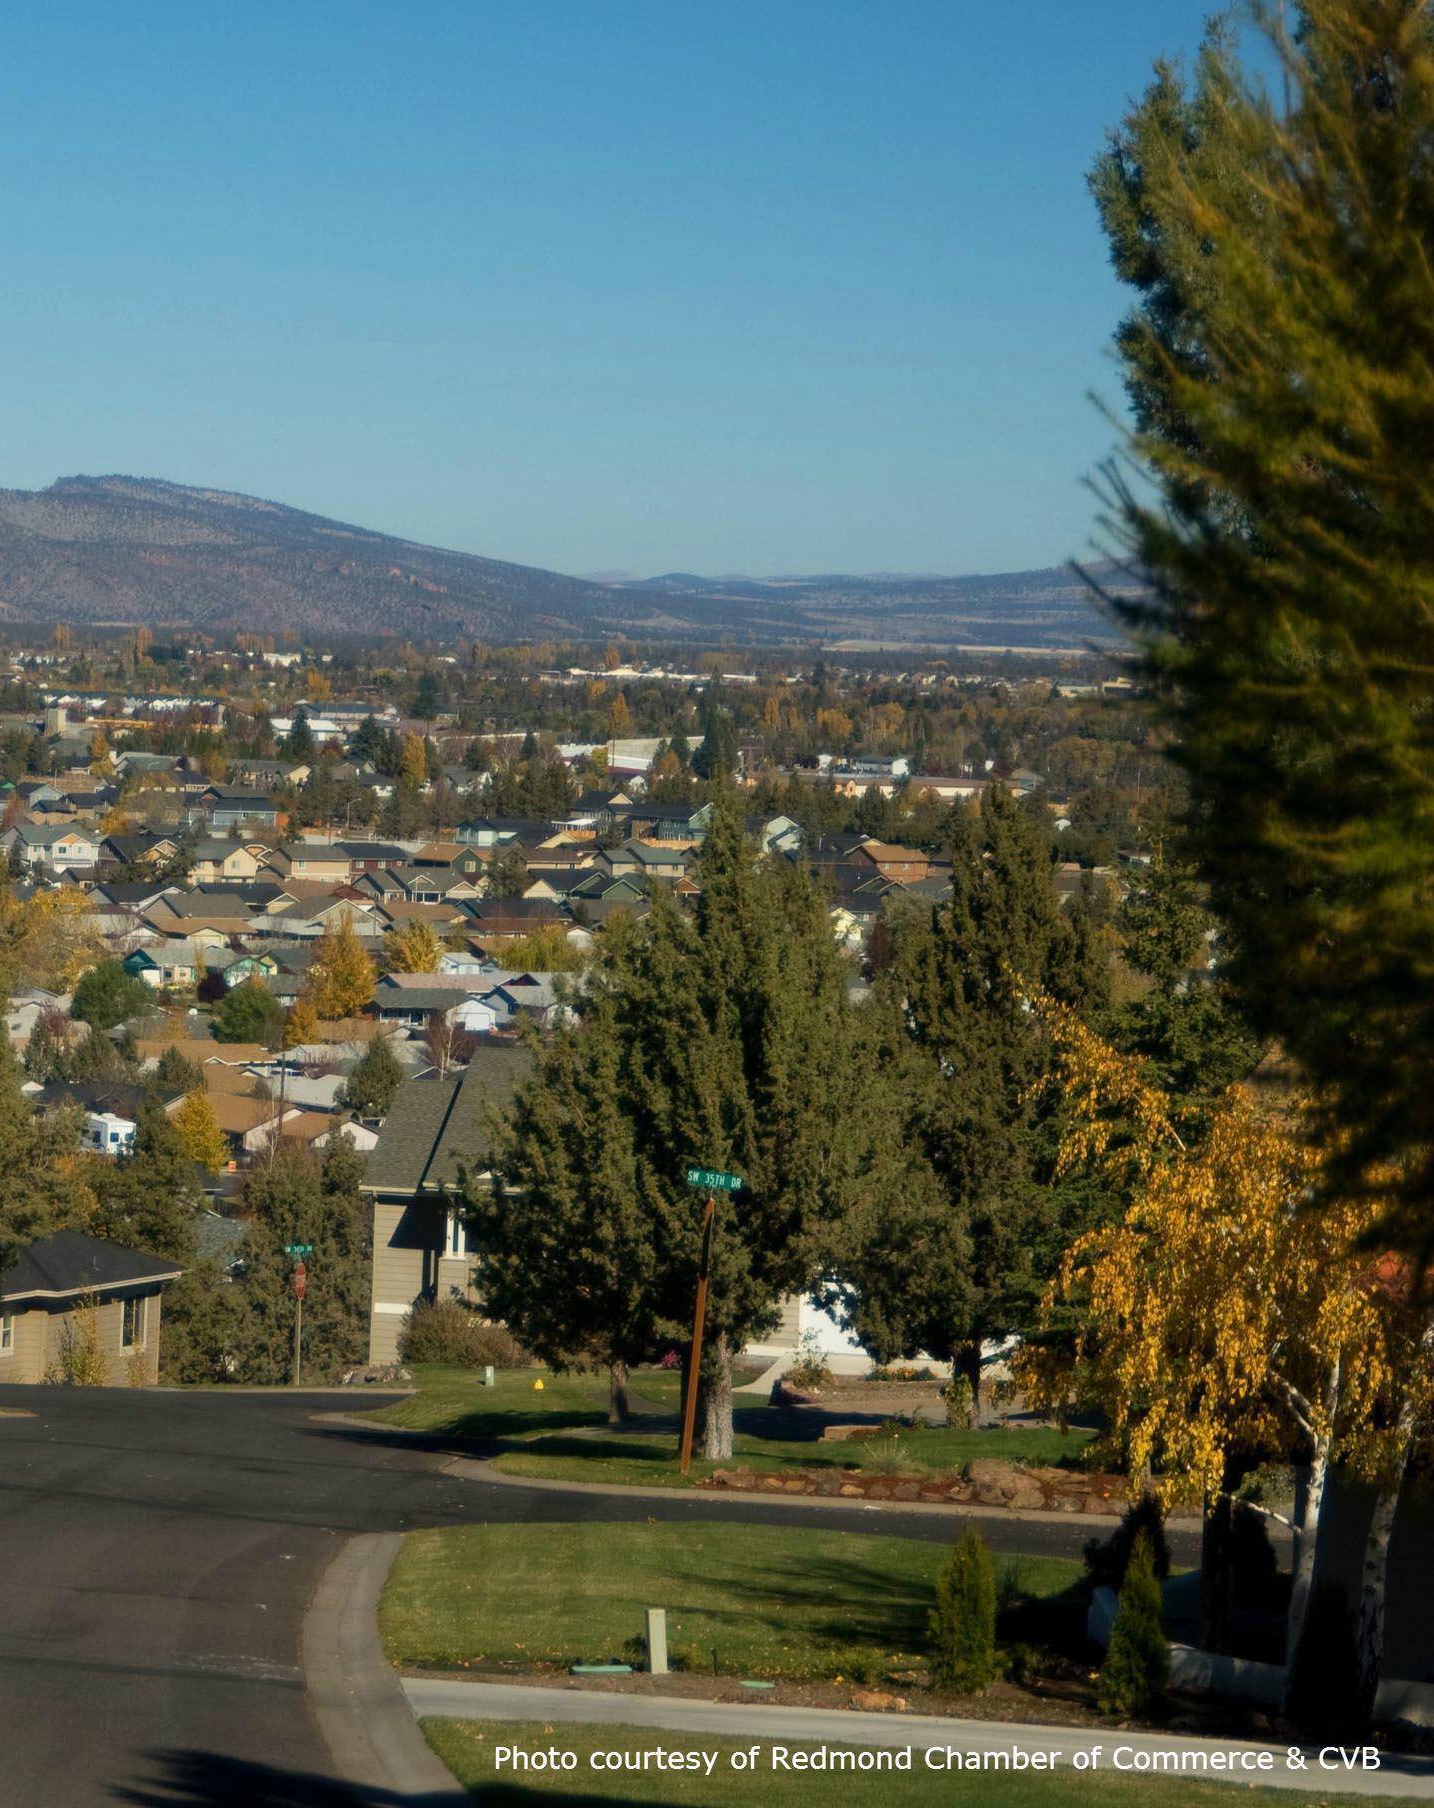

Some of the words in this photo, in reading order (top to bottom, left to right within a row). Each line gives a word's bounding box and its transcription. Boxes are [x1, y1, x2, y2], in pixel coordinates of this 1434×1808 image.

[687, 1170, 699, 1182] SW
[705, 1173, 725, 1185] 35TH
[730, 1177, 741, 1188] DR
